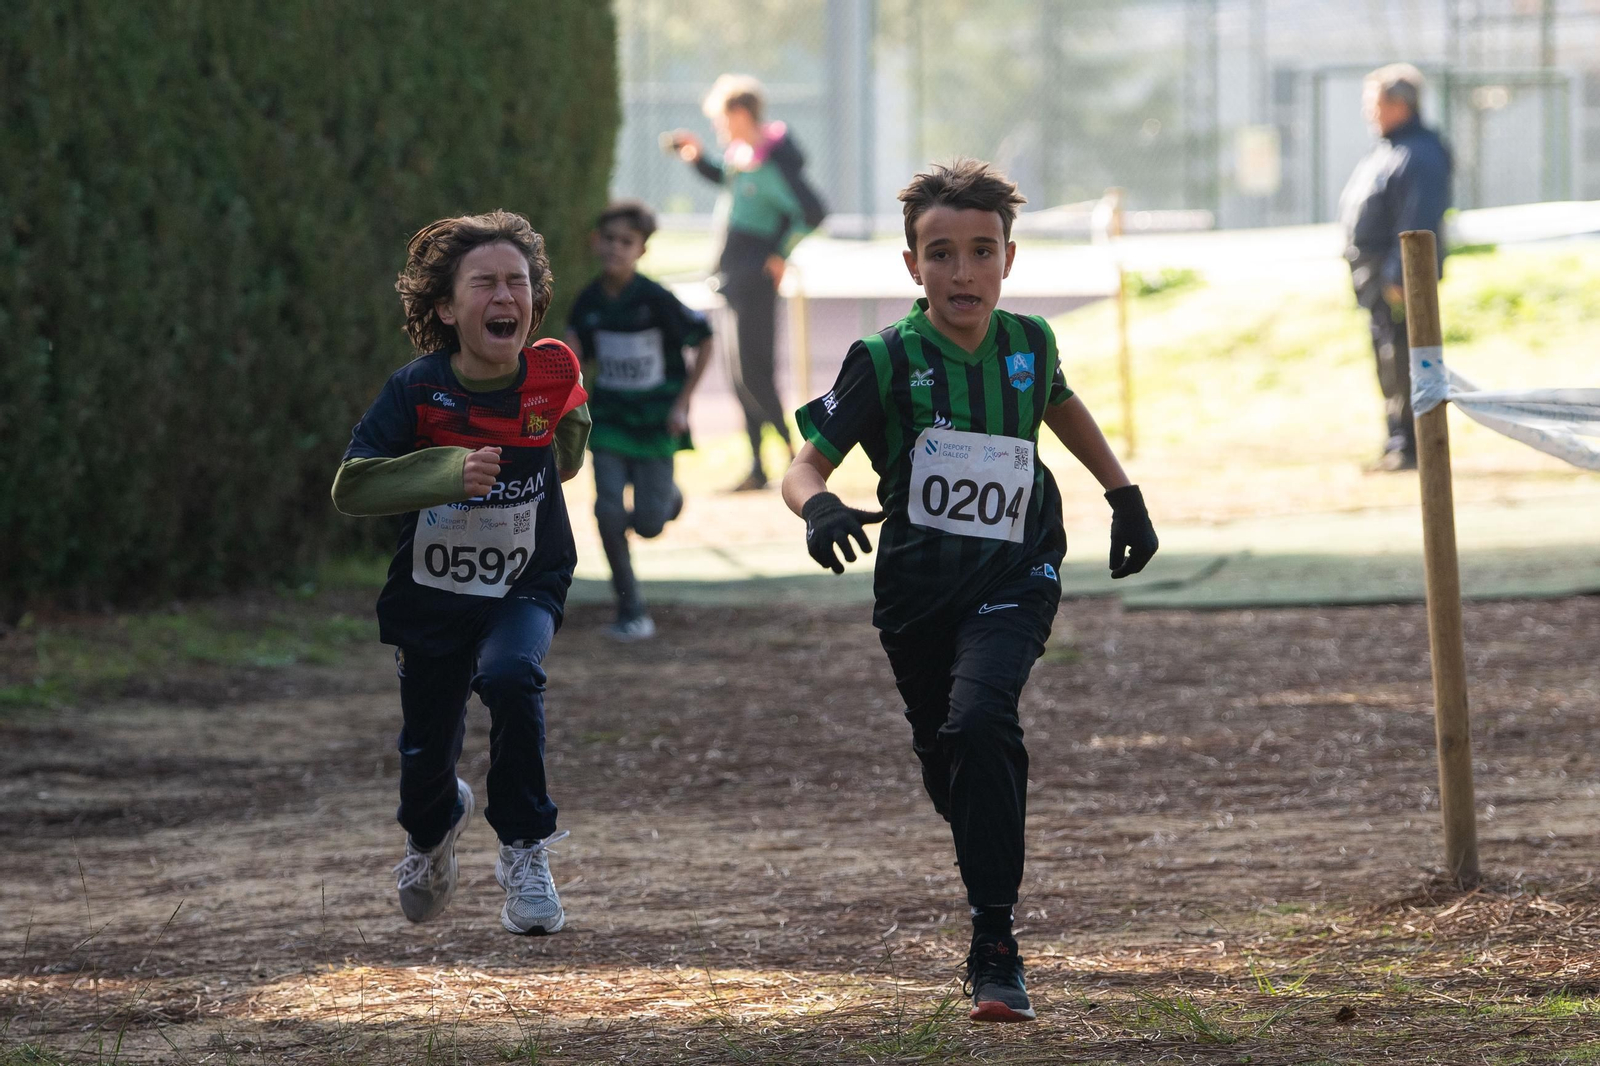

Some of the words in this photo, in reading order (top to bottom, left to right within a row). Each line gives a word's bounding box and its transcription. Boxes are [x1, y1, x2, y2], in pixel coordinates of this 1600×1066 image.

[942, 451, 969, 460] GALEGO
[943, 443, 972, 452] DEPORTE
[468, 466, 547, 502] RSAN
[922, 474, 1025, 528] 0204
[440, 523, 466, 531] GALEGO
[424, 543, 529, 586] 0592
